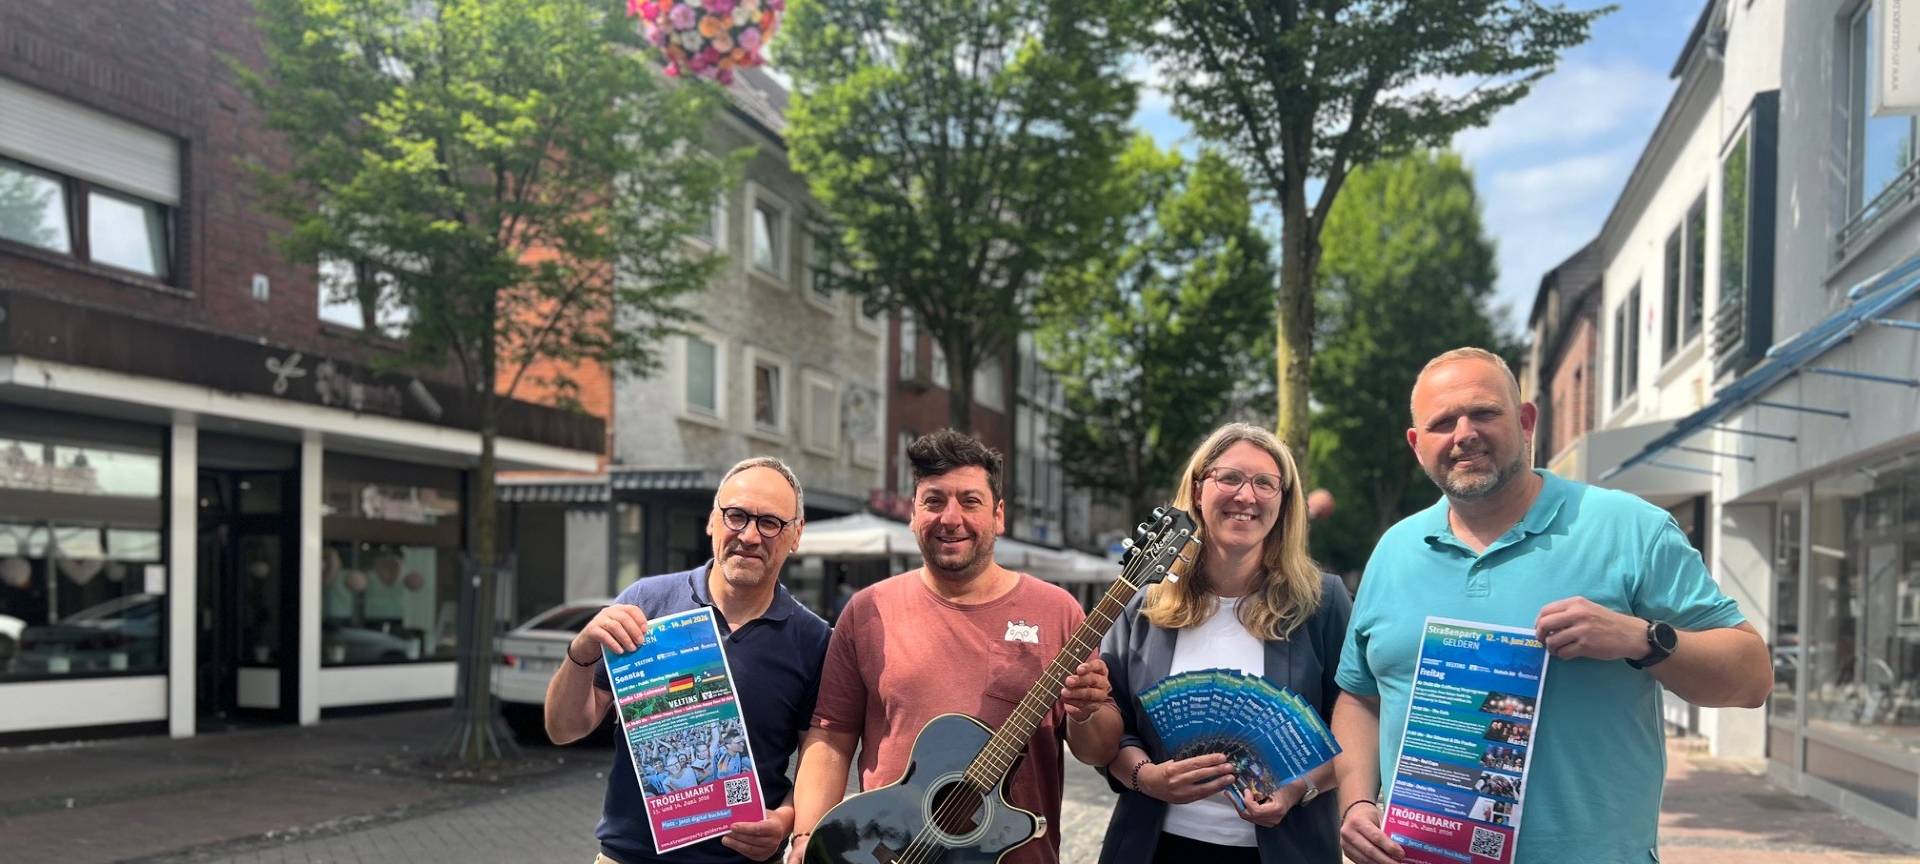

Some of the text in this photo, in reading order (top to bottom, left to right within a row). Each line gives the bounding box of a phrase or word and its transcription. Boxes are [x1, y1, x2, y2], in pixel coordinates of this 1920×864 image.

[1428, 625, 1482, 640] Straßenparty
[1442, 637, 1480, 650] GELDERN
[615, 670, 645, 684] Sonntag
[1420, 668, 1445, 680] Freitag
[669, 695, 698, 708] VELTINS
[650, 784, 714, 808] TRÖDELMARKT
[1391, 807, 1463, 831] TRÖDELMARKT
